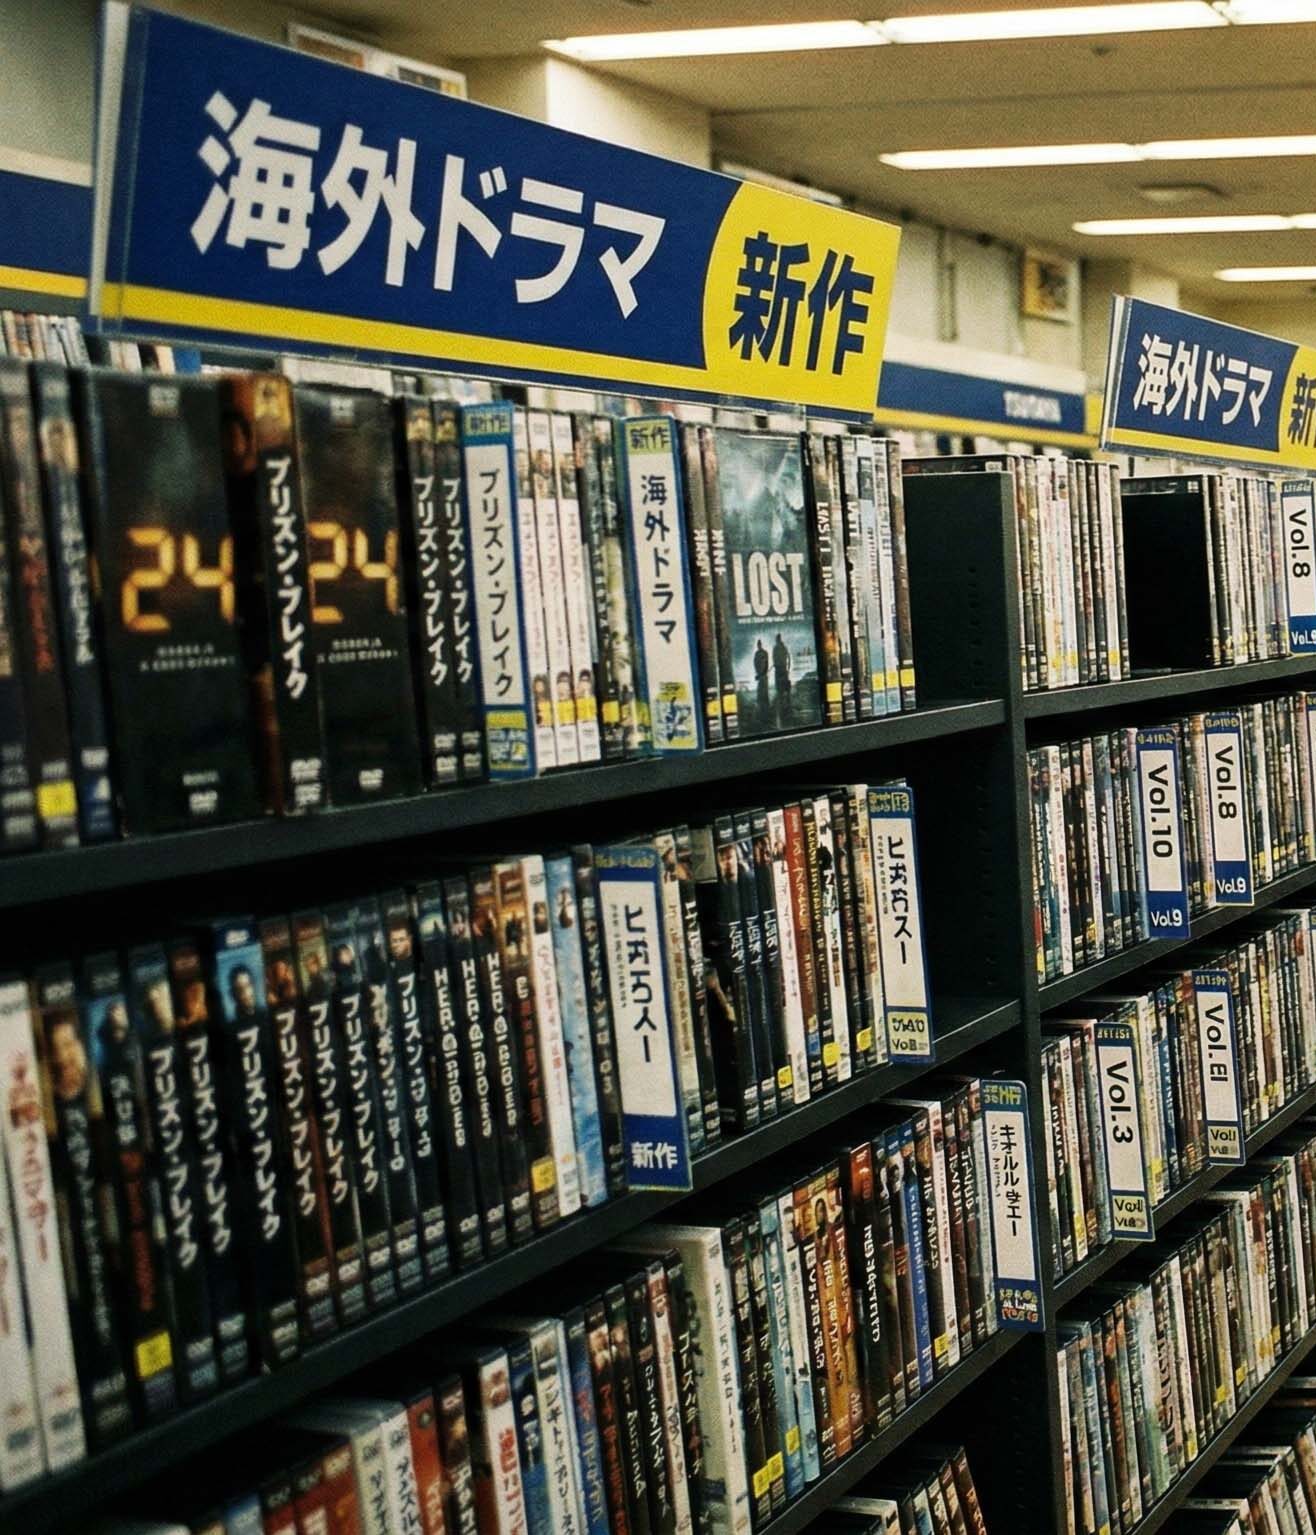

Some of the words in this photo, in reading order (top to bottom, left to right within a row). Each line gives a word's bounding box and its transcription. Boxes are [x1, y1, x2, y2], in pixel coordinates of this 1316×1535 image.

[190, 90, 667, 320] 海外ドラマ
[728, 231, 876, 377] 新作
[1133, 333, 1273, 427] 海外ドラマ
[121, 527, 235, 633] 24
[308, 521, 399, 625] 24
[640, 474, 678, 645] 海外ドラマ
[731, 551, 804, 617] LOST
[1288, 508, 1311, 578] Vol.8
[1148, 763, 1172, 859] Vol.10
[1214, 745, 1237, 819] Vol.8
[1105, 1060, 1134, 1145] Vol.3
[631, 1141, 679, 1171] 新作
